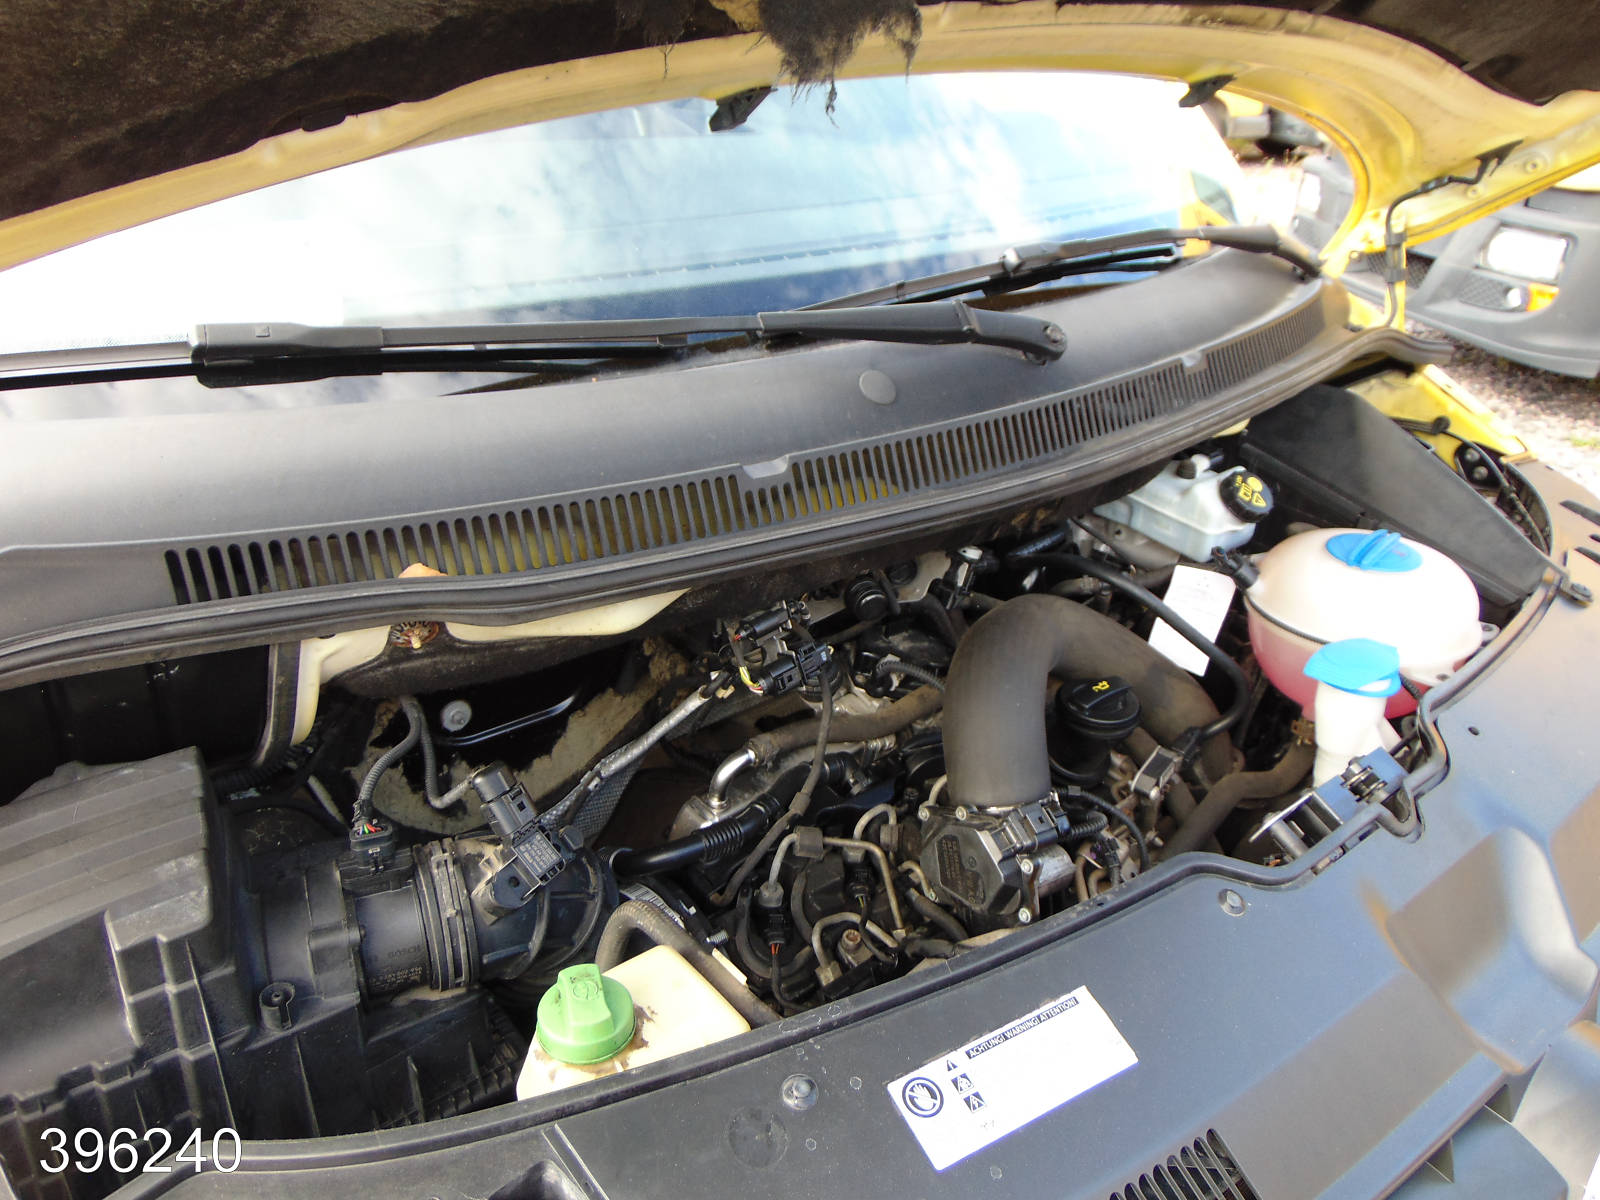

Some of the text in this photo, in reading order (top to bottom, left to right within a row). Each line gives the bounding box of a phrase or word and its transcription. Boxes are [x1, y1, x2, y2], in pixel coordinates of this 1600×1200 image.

[968, 997, 1078, 1058] ACHTUNG! WARNING! ATTENTION!
